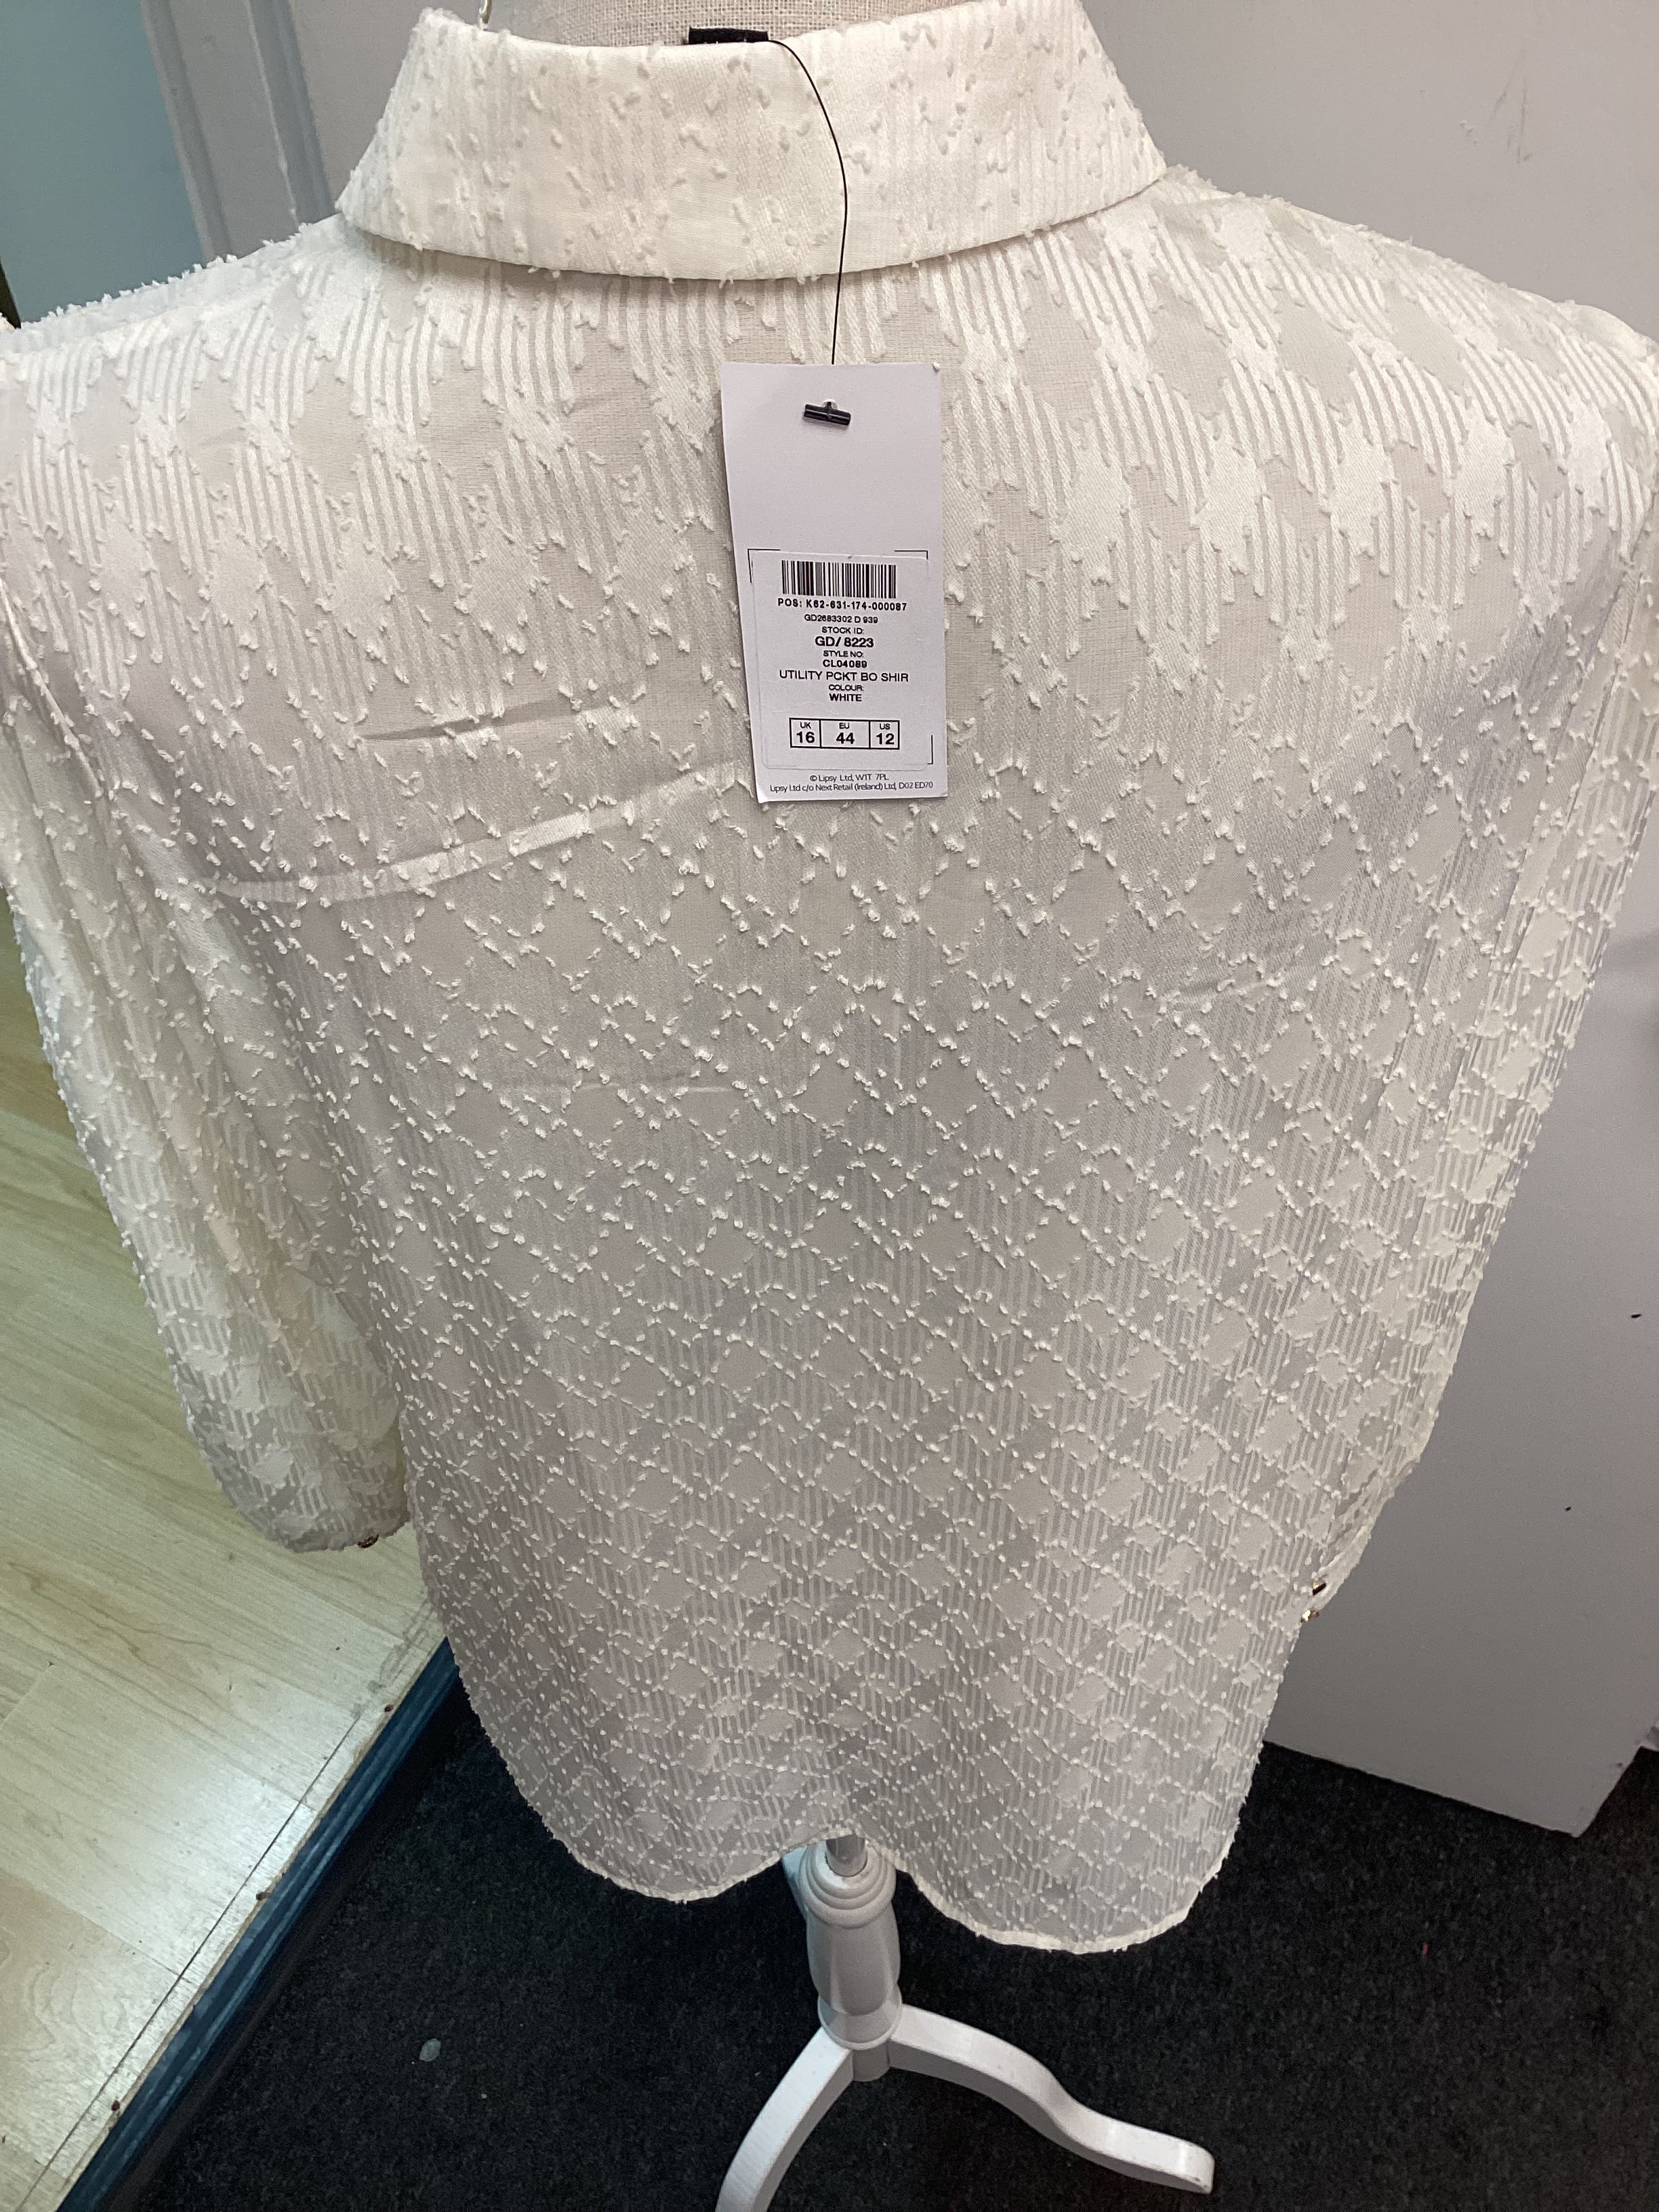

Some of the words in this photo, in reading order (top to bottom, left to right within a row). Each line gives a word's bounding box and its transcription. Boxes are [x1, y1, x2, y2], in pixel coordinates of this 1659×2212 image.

[777, 598, 802, 608] POS:
[806, 599, 907, 611] K62-631-174-000087
[821, 626, 851, 634] STOCK
[815, 636, 841, 647] GD/
[844, 638, 874, 648] 8223
[823, 659, 867, 668] CL04089
[779, 670, 823, 680] UTILITY
[826, 671, 857, 681] PCKT
[861, 672, 878, 682] BO
[881, 672, 909, 682] SHIR
[829, 693, 862, 701] WHITE
[796, 731, 815, 743] 16
[836, 732, 855, 744] 44
[876, 733, 895, 745] 12
[818, 774, 837, 783] Lipsy
[770, 785, 787, 794] Lipsy
[855, 783, 883, 792] (Ireland)
